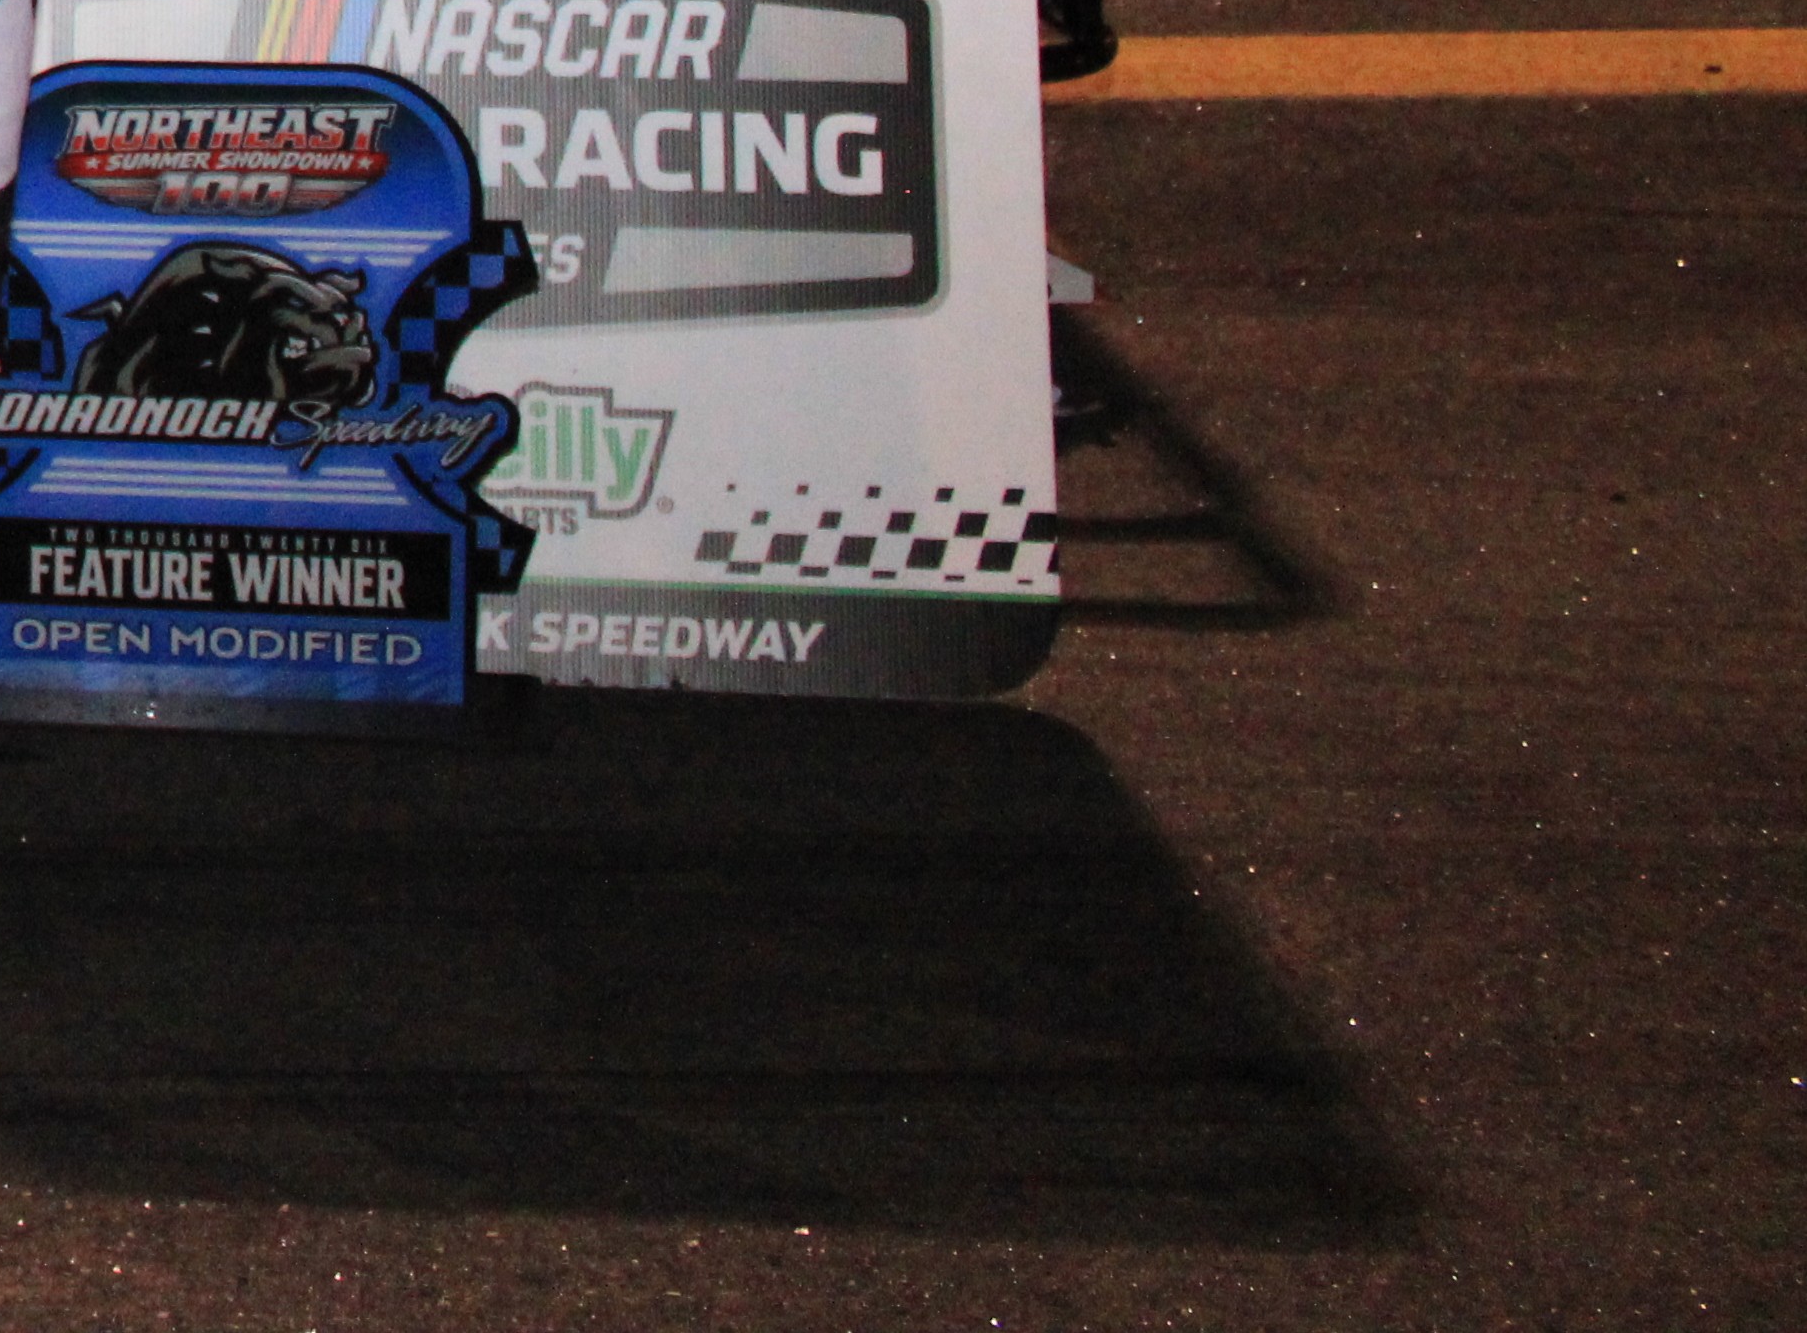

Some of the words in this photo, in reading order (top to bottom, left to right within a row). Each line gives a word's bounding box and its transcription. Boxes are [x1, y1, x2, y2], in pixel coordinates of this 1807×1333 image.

[68, 104, 396, 153] NORTHEAST
[480, 107, 885, 196] RACING
[106, 151, 210, 172] SUMMER
[215, 151, 353, 172] SHOWDOWN
[154, 170, 292, 216] 100
[270, 399, 496, 470] Speedway
[50, 527, 95, 544] TWO
[109, 529, 230, 550] THOUSAND
[244, 533, 337, 553] TWENTY
[350, 538, 387, 555] SIX
[30, 545, 215, 602] FEATURE
[227, 550, 406, 610] WINNER
[12, 618, 152, 655] OPEN
[170, 625, 423, 666] MODIFIED
[528, 609, 826, 664] SPEEDWAY
